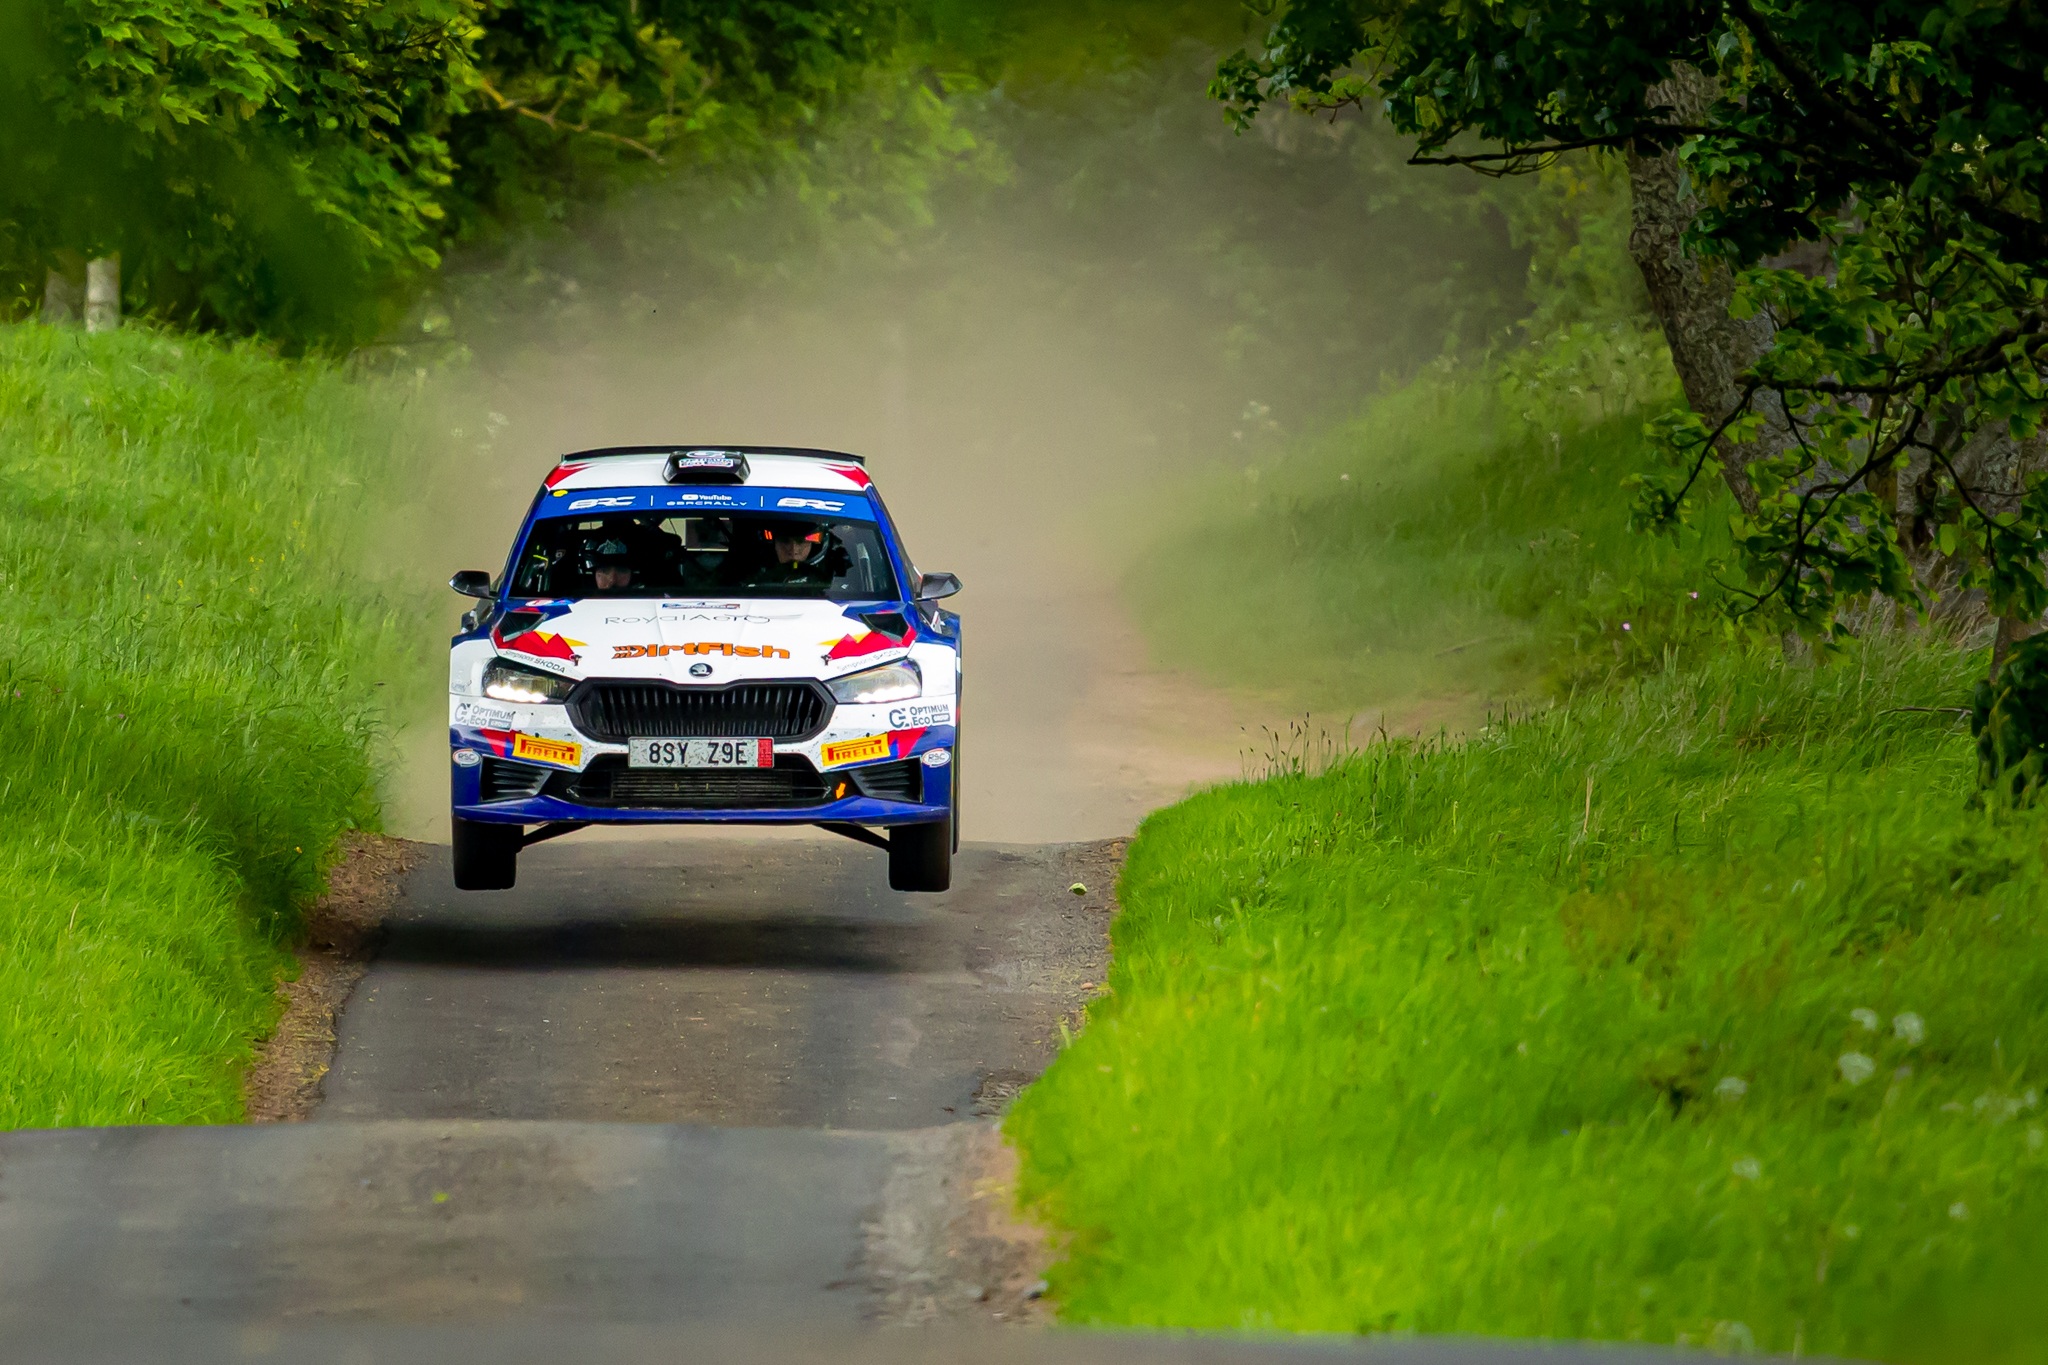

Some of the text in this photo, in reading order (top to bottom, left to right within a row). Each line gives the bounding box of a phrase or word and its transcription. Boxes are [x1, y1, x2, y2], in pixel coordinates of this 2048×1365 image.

[472, 704, 514, 720] OPTIMUM
[909, 704, 949, 716] OPTIMUM
[470, 715, 487, 726] ECO
[912, 716, 931, 726] ECO
[520, 739, 575, 761] PIRELLI
[649, 742, 689, 764] 8SY
[707, 742, 748, 764] Z9E
[827, 740, 882, 762] PIRELLI
[928, 751, 946, 761] RSC
